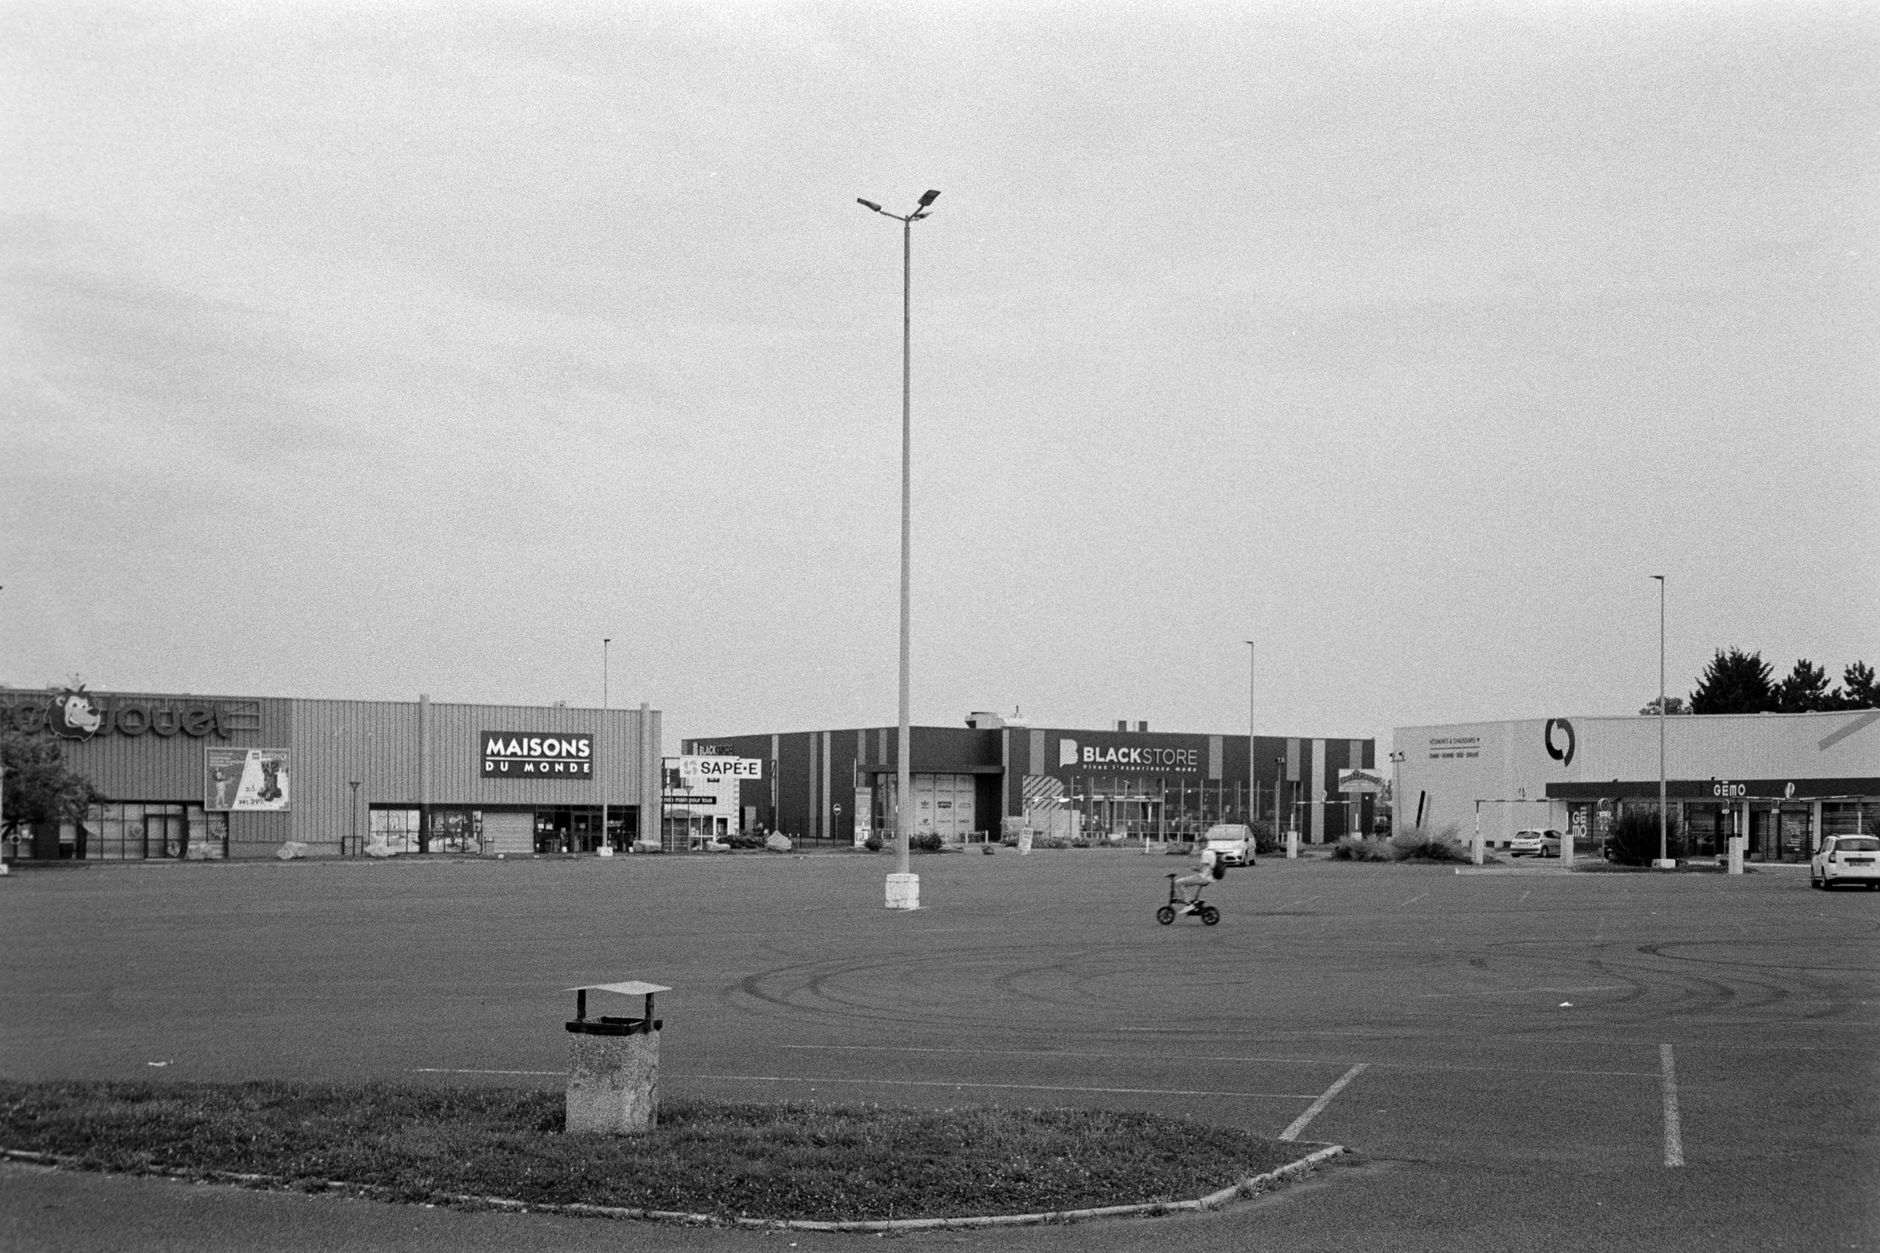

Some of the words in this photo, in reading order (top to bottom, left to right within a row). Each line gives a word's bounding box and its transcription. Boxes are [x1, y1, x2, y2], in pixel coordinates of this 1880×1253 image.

[95, 695, 233, 739] Jouet
[486, 737, 590, 757] MAISONS
[1083, 747, 1198, 765] BLACKSTORE
[485, 761, 508, 772] DU
[524, 762, 590, 773] MONDE
